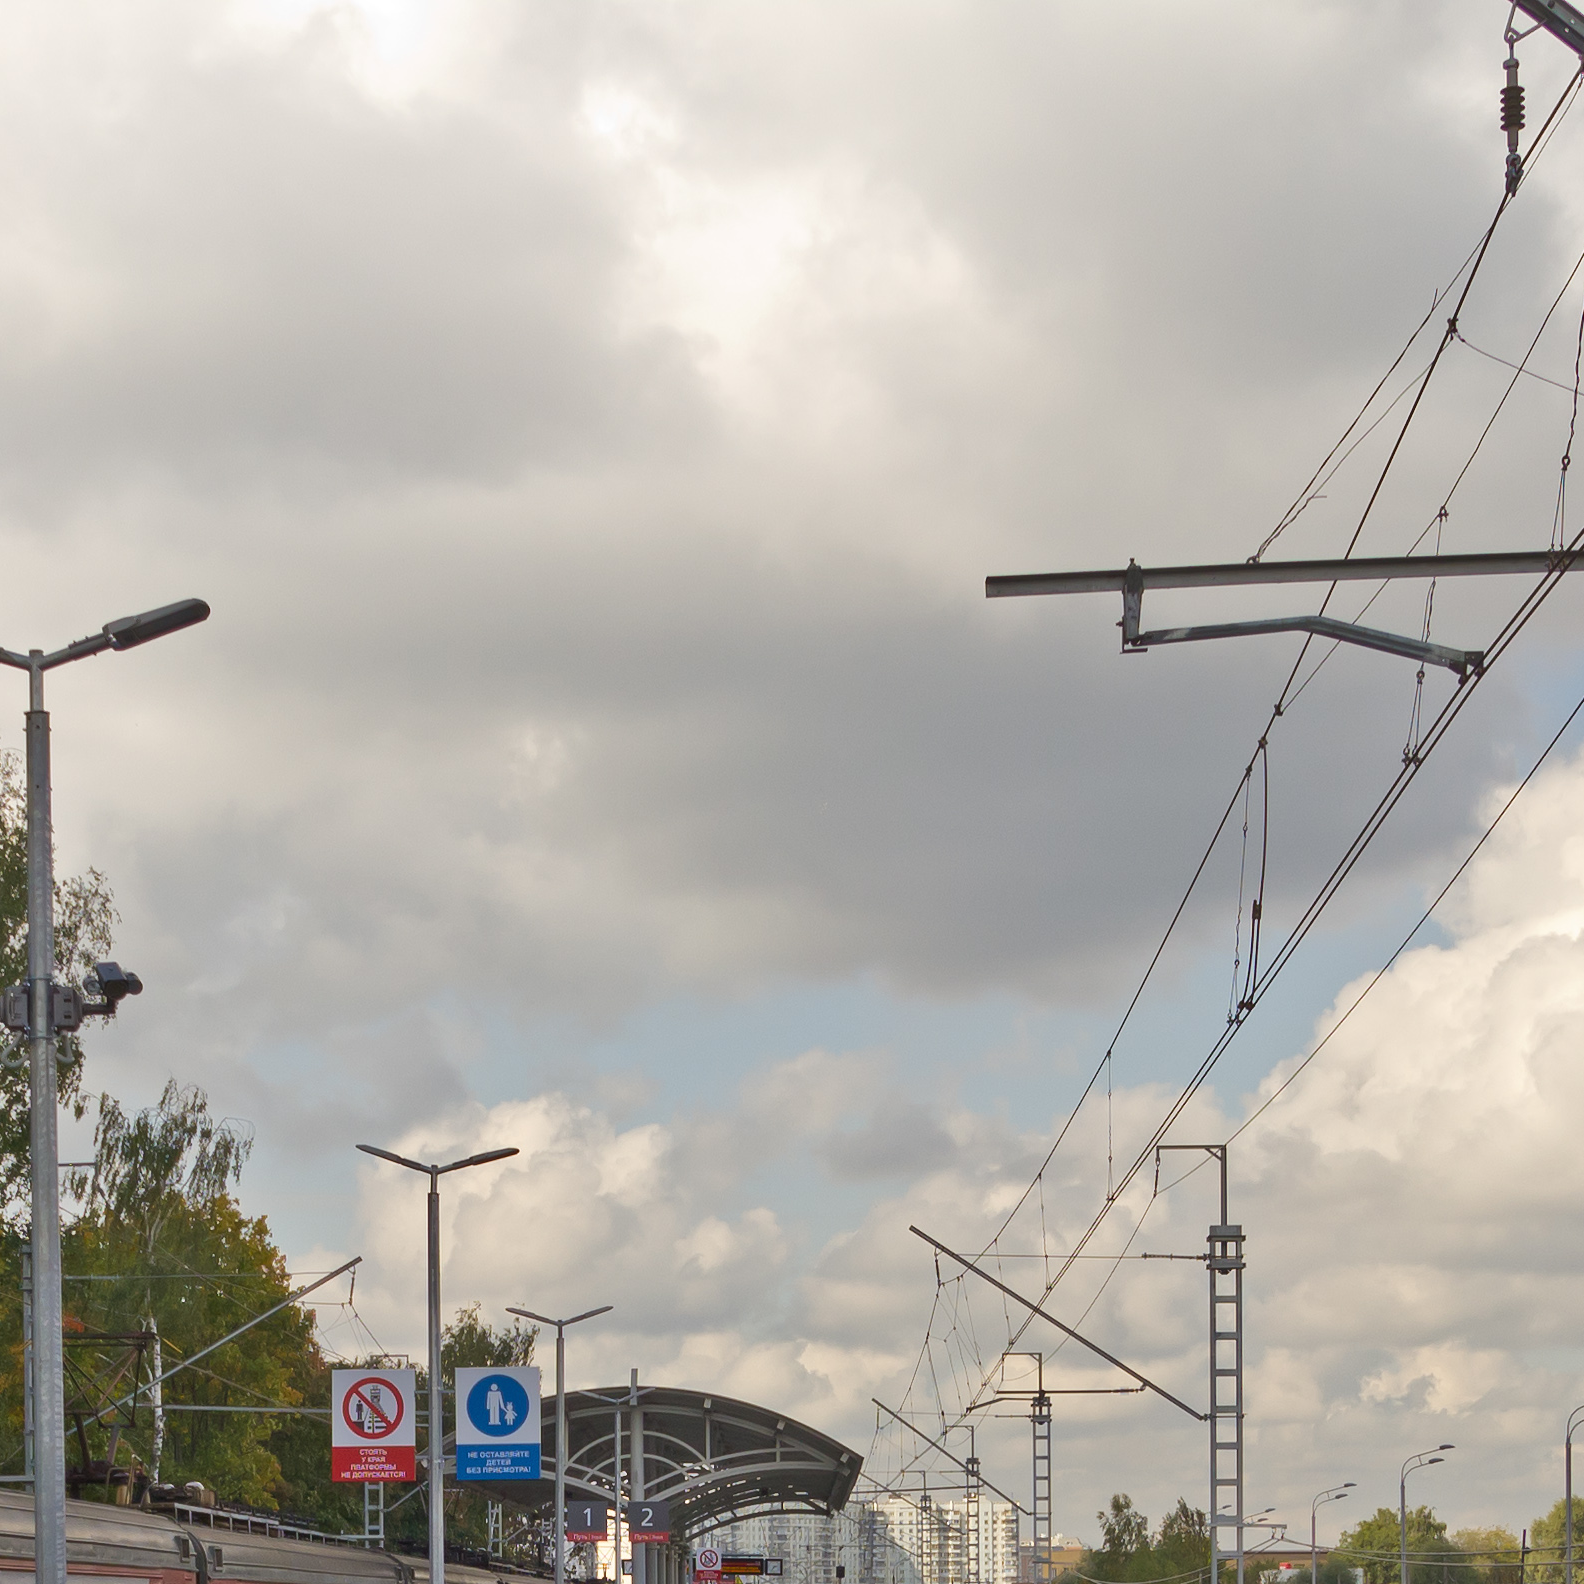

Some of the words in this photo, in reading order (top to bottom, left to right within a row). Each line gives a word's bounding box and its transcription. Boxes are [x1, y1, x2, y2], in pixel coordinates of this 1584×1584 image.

[359, 1448, 388, 1456] СТОЯТЬ
[467, 1451, 478, 1459] НЕ
[479, 1450, 530, 1458] ОСТАВЛЯЙТЕ
[485, 1458, 512, 1467] ДЕТЕЙ
[350, 1463, 397, 1471] ПЛАТФОРМЫ
[466, 1466, 481, 1474] БЕЗ
[482, 1466, 531, 1474] ПРИСМОТРА!
[351, 1471, 406, 1479] ДОПУСКАЕТСЯ!
[582, 1507, 592, 1527] 1
[640, 1507, 654, 1527] 2
